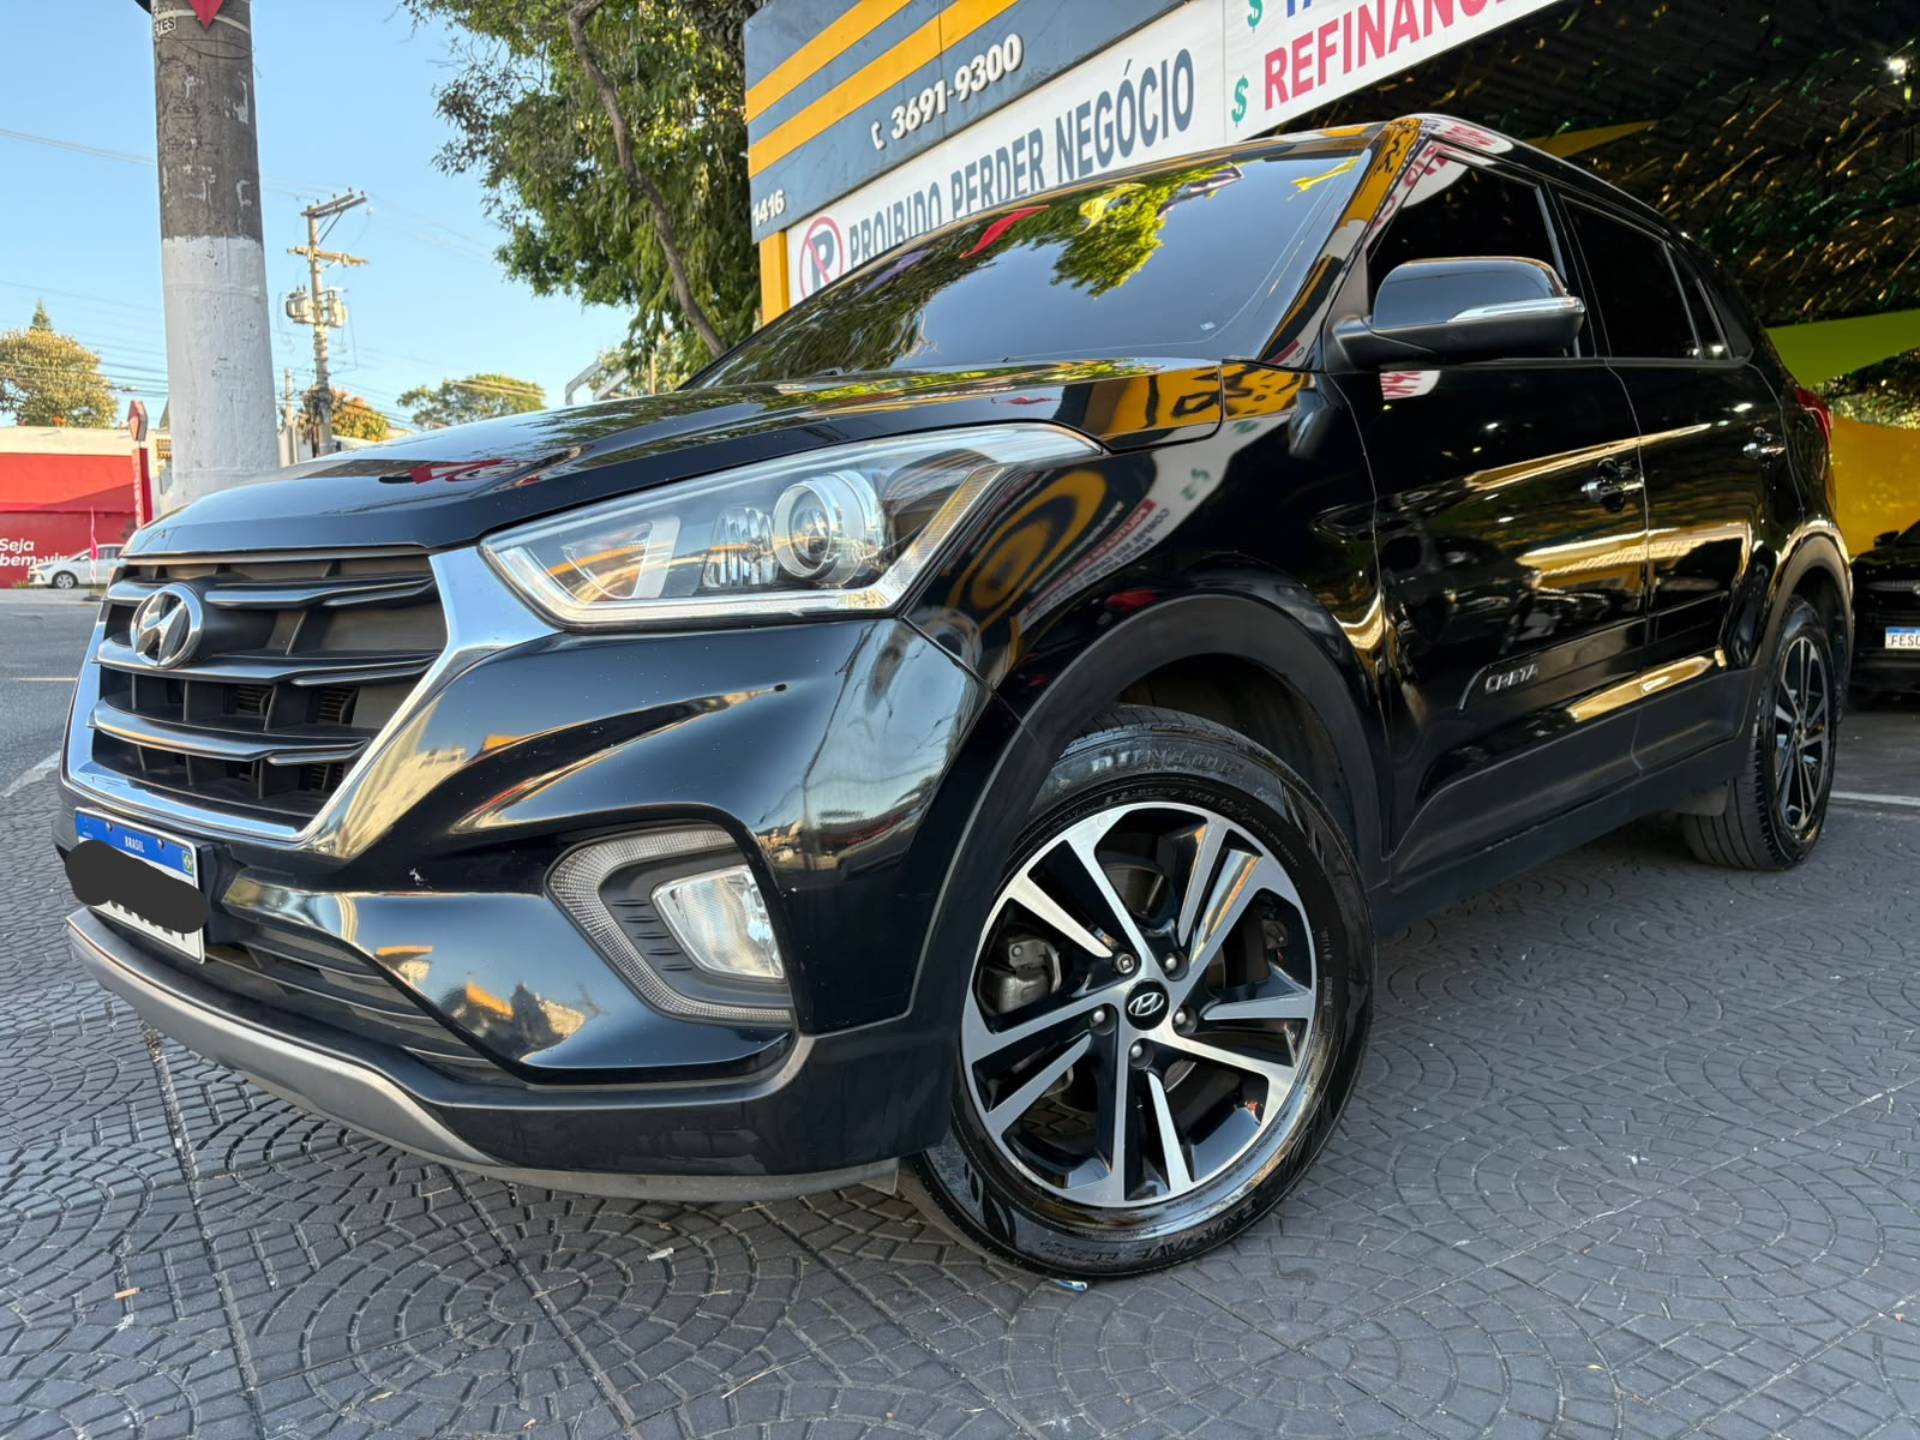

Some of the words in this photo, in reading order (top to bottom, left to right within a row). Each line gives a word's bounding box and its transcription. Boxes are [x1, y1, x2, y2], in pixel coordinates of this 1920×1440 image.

[891, 33, 1023, 140] 3691-9300
[848, 181, 943, 268] PROIBIDO
[950, 127, 1046, 219] PERDER
[1055, 48, 1195, 184] NEGÓCIO
[751, 189, 785, 228] 1416
[0, 538, 35, 554] Seja
[1484, 663, 1539, 695] CRETA
